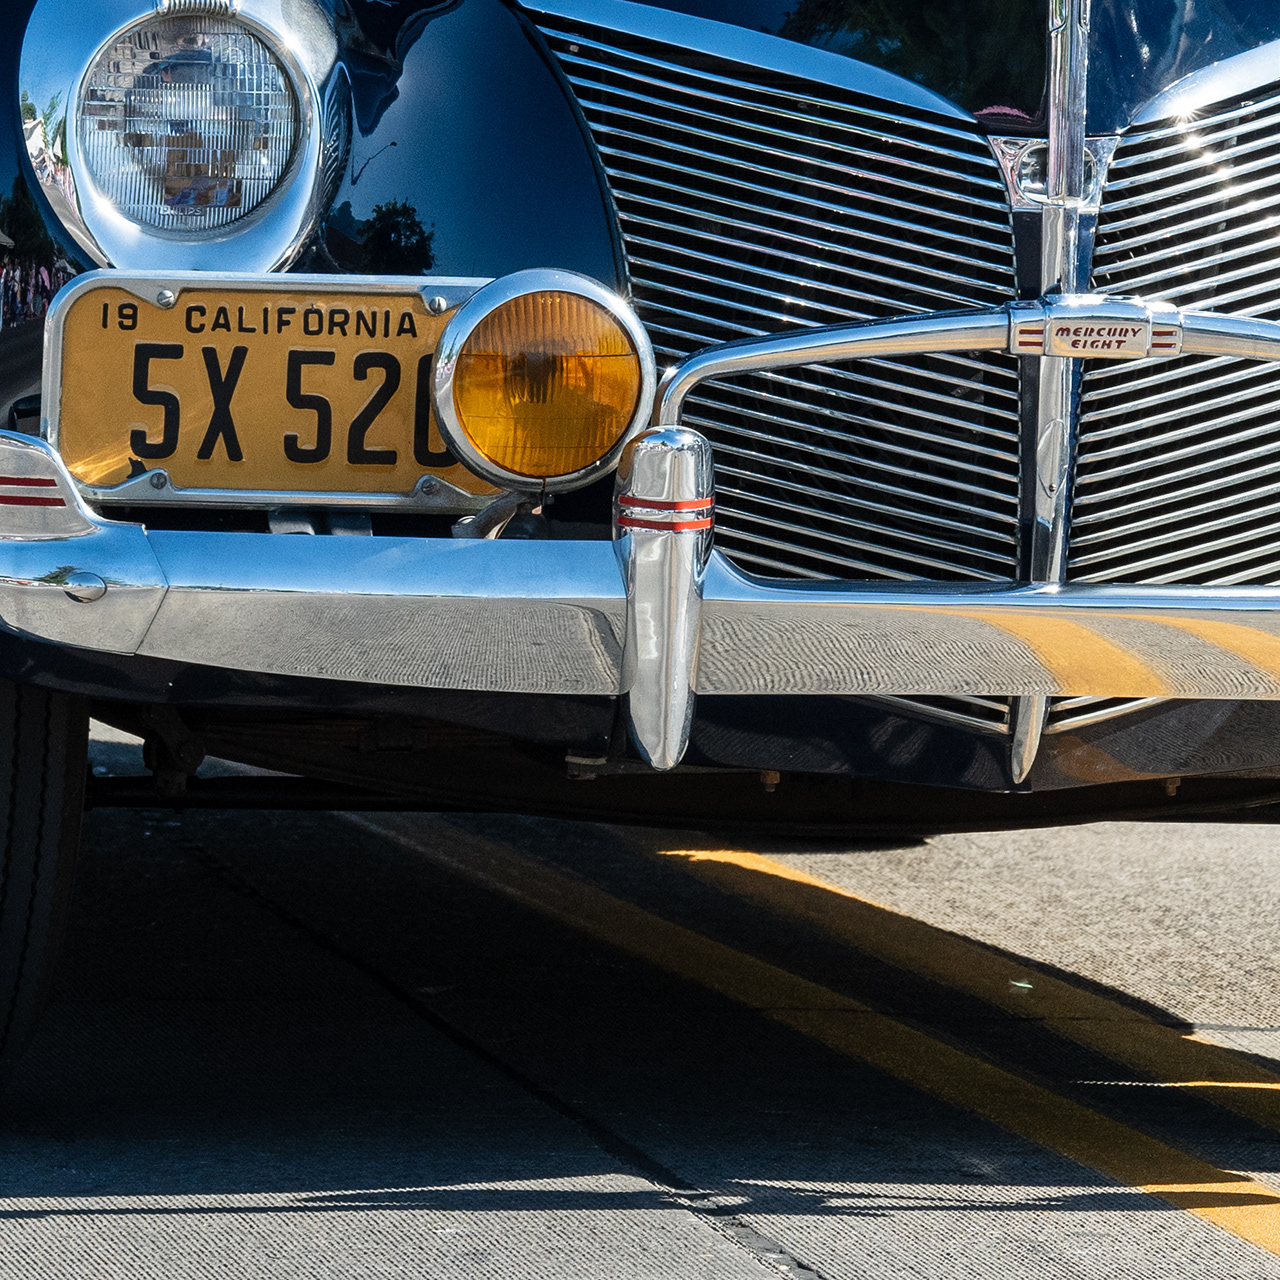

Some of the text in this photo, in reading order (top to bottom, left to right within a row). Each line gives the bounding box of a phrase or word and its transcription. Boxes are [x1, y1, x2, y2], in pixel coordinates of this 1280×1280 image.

[102, 302, 418, 339] 19 CALIFORNIA
[1055, 327, 1142, 338] MERCURY
[1071, 339, 1127, 350] EIGHT
[129, 343, 249, 462] 5X
